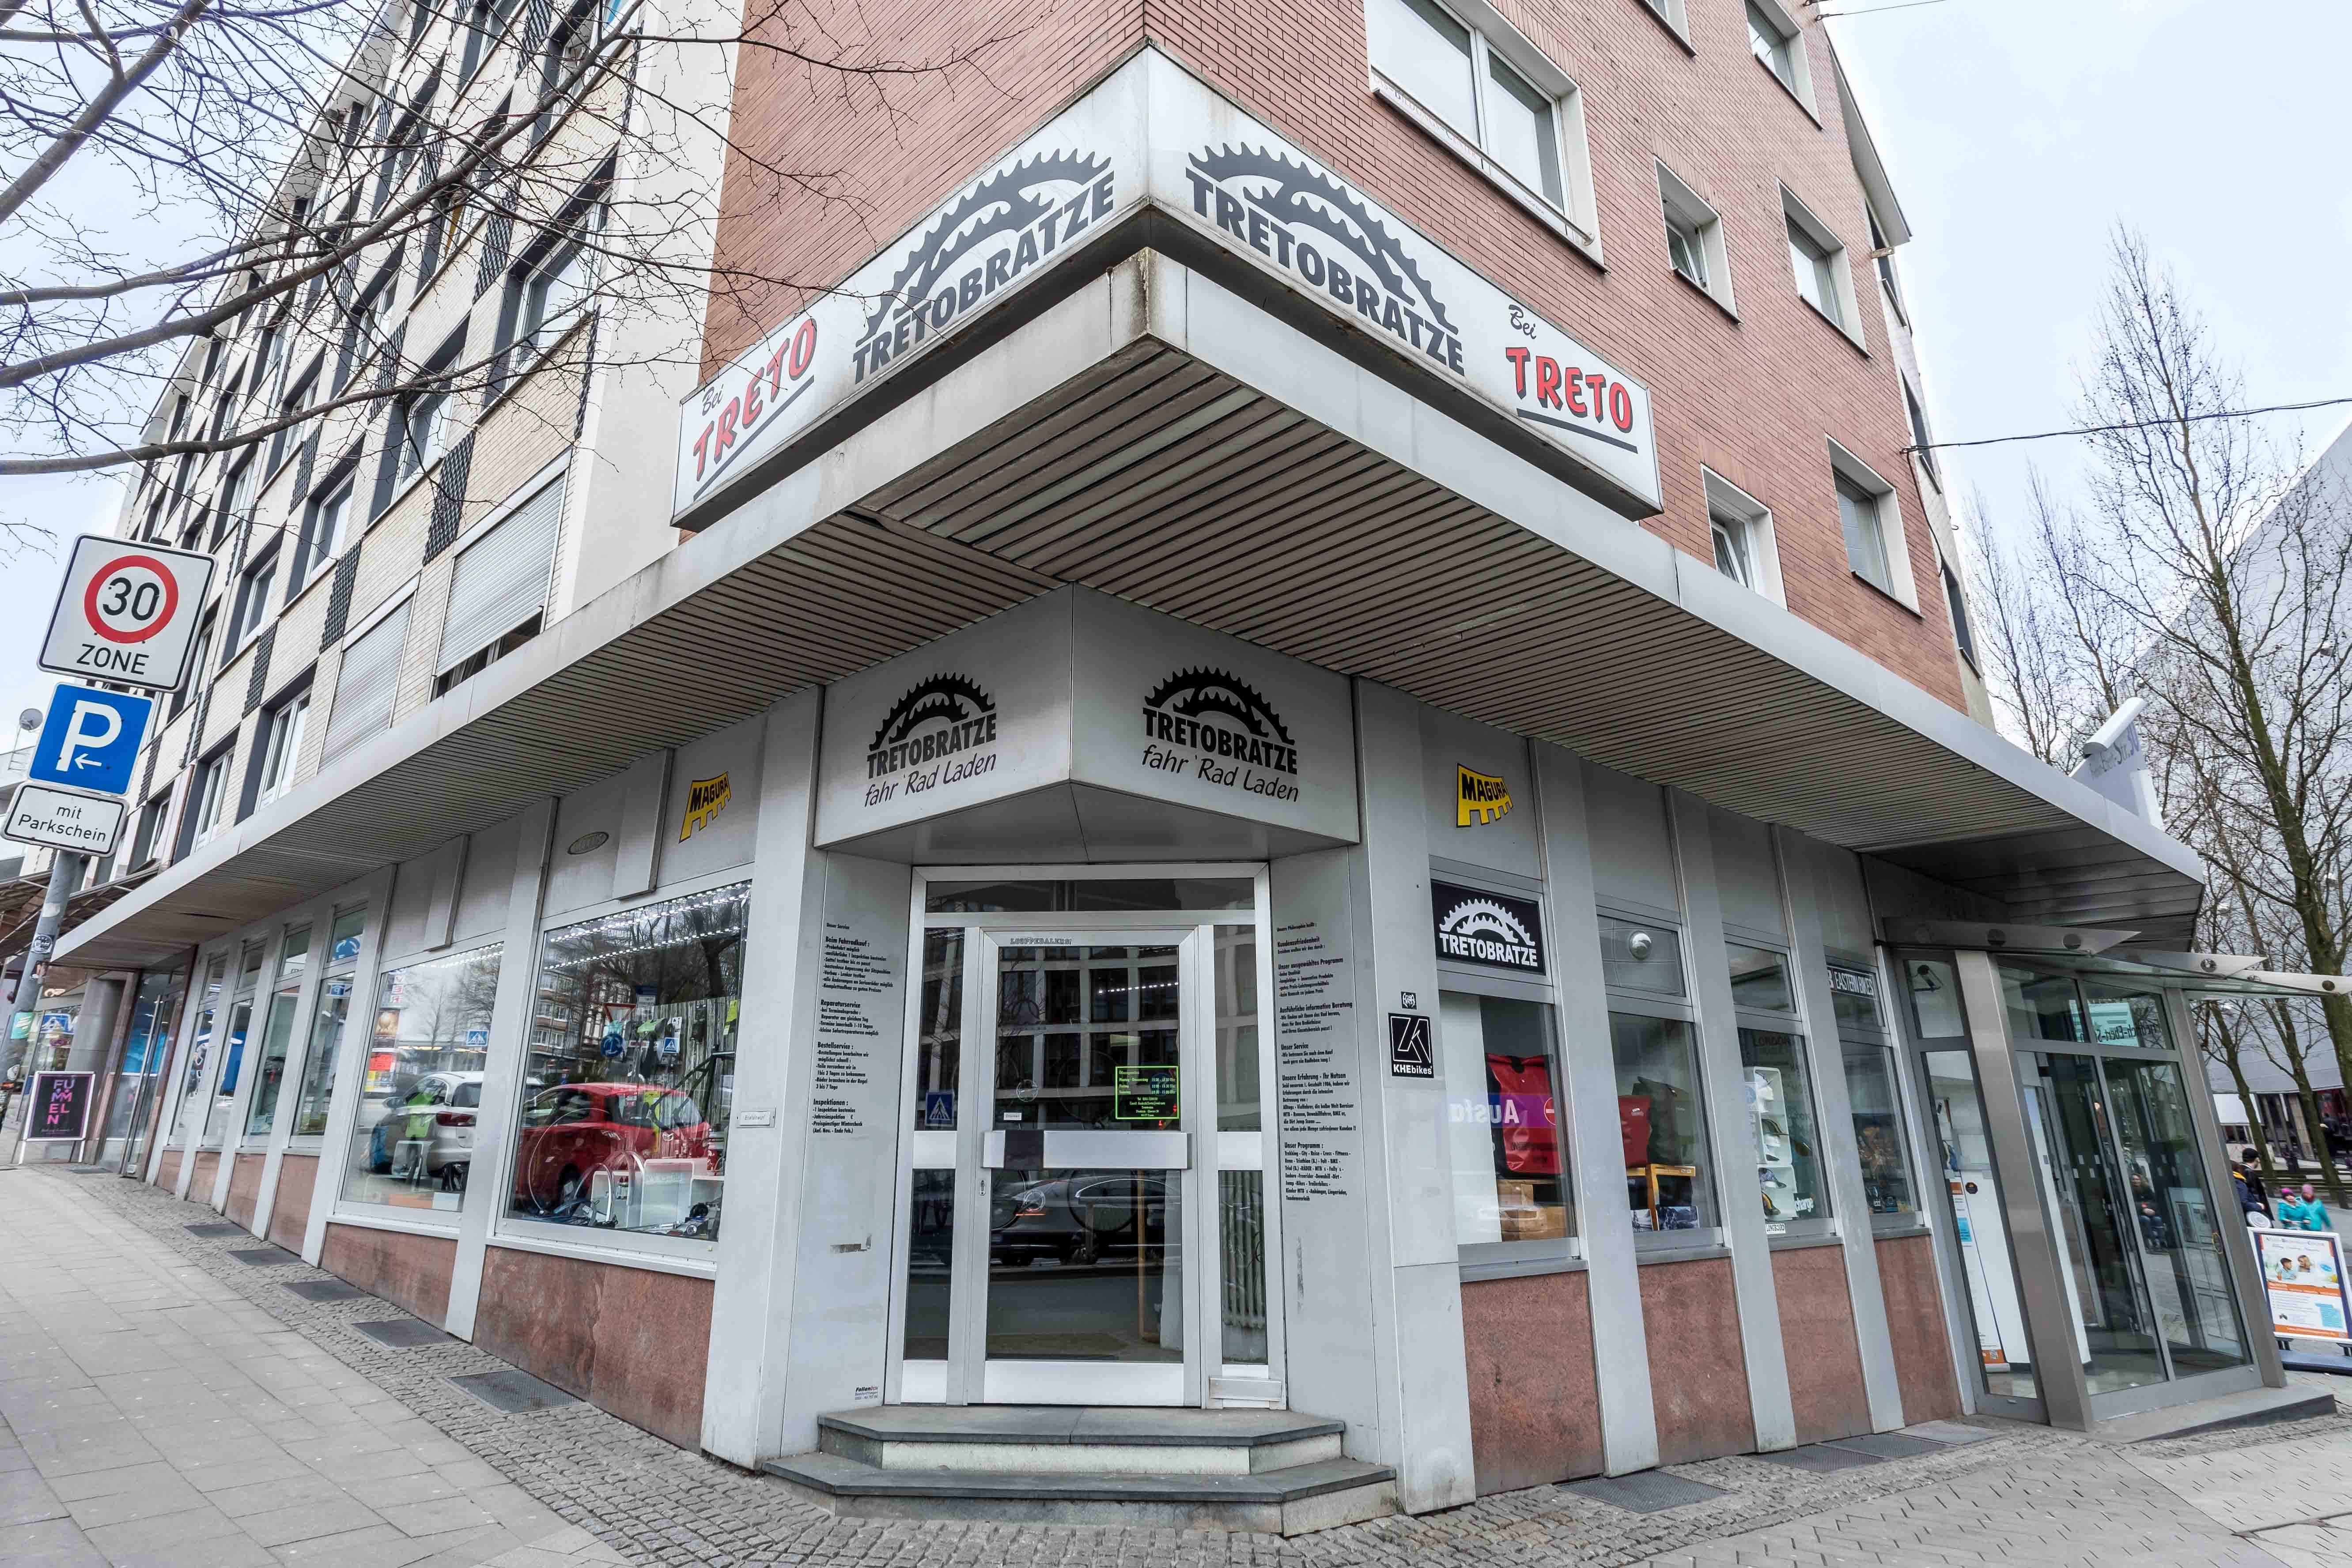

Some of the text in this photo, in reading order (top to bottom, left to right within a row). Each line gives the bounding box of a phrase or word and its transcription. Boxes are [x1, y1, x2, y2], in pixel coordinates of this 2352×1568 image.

[853, 170, 1114, 384] TRETOBRATZE
[1185, 167, 1465, 377] TRETOBRATZE
[1507, 305, 1537, 340] Bei
[693, 318, 817, 482] TRETO
[702, 383, 724, 417] Bei
[1505, 347, 1633, 432] TRETO
[102, 577, 160, 621] 30
[77, 643, 150, 675] ZONE
[56, 700, 122, 772] P
[866, 713, 997, 780] TRETOBRATZE
[1143, 707, 1297, 775] TRETOBRATZE
[864, 781, 898, 808] fahr
[943, 752, 997, 785] Laden
[1142, 744, 1189, 774] fahr
[1243, 770, 1300, 803] Laden
[1462, 773, 1507, 802] MAGURA
[689, 777, 728, 812] MAGURA
[18, 814, 106, 842] Parkschein
[57, 806, 82, 820] mit
[1278, 936, 1320, 947] Kundenzufriedenheit
[1439, 933, 1538, 967] TRETOBRATZE
[54, 1080, 75, 1089] FU
[1393, 1064, 1432, 1074] KHEbikes
[49, 1103, 70, 1113] EL
